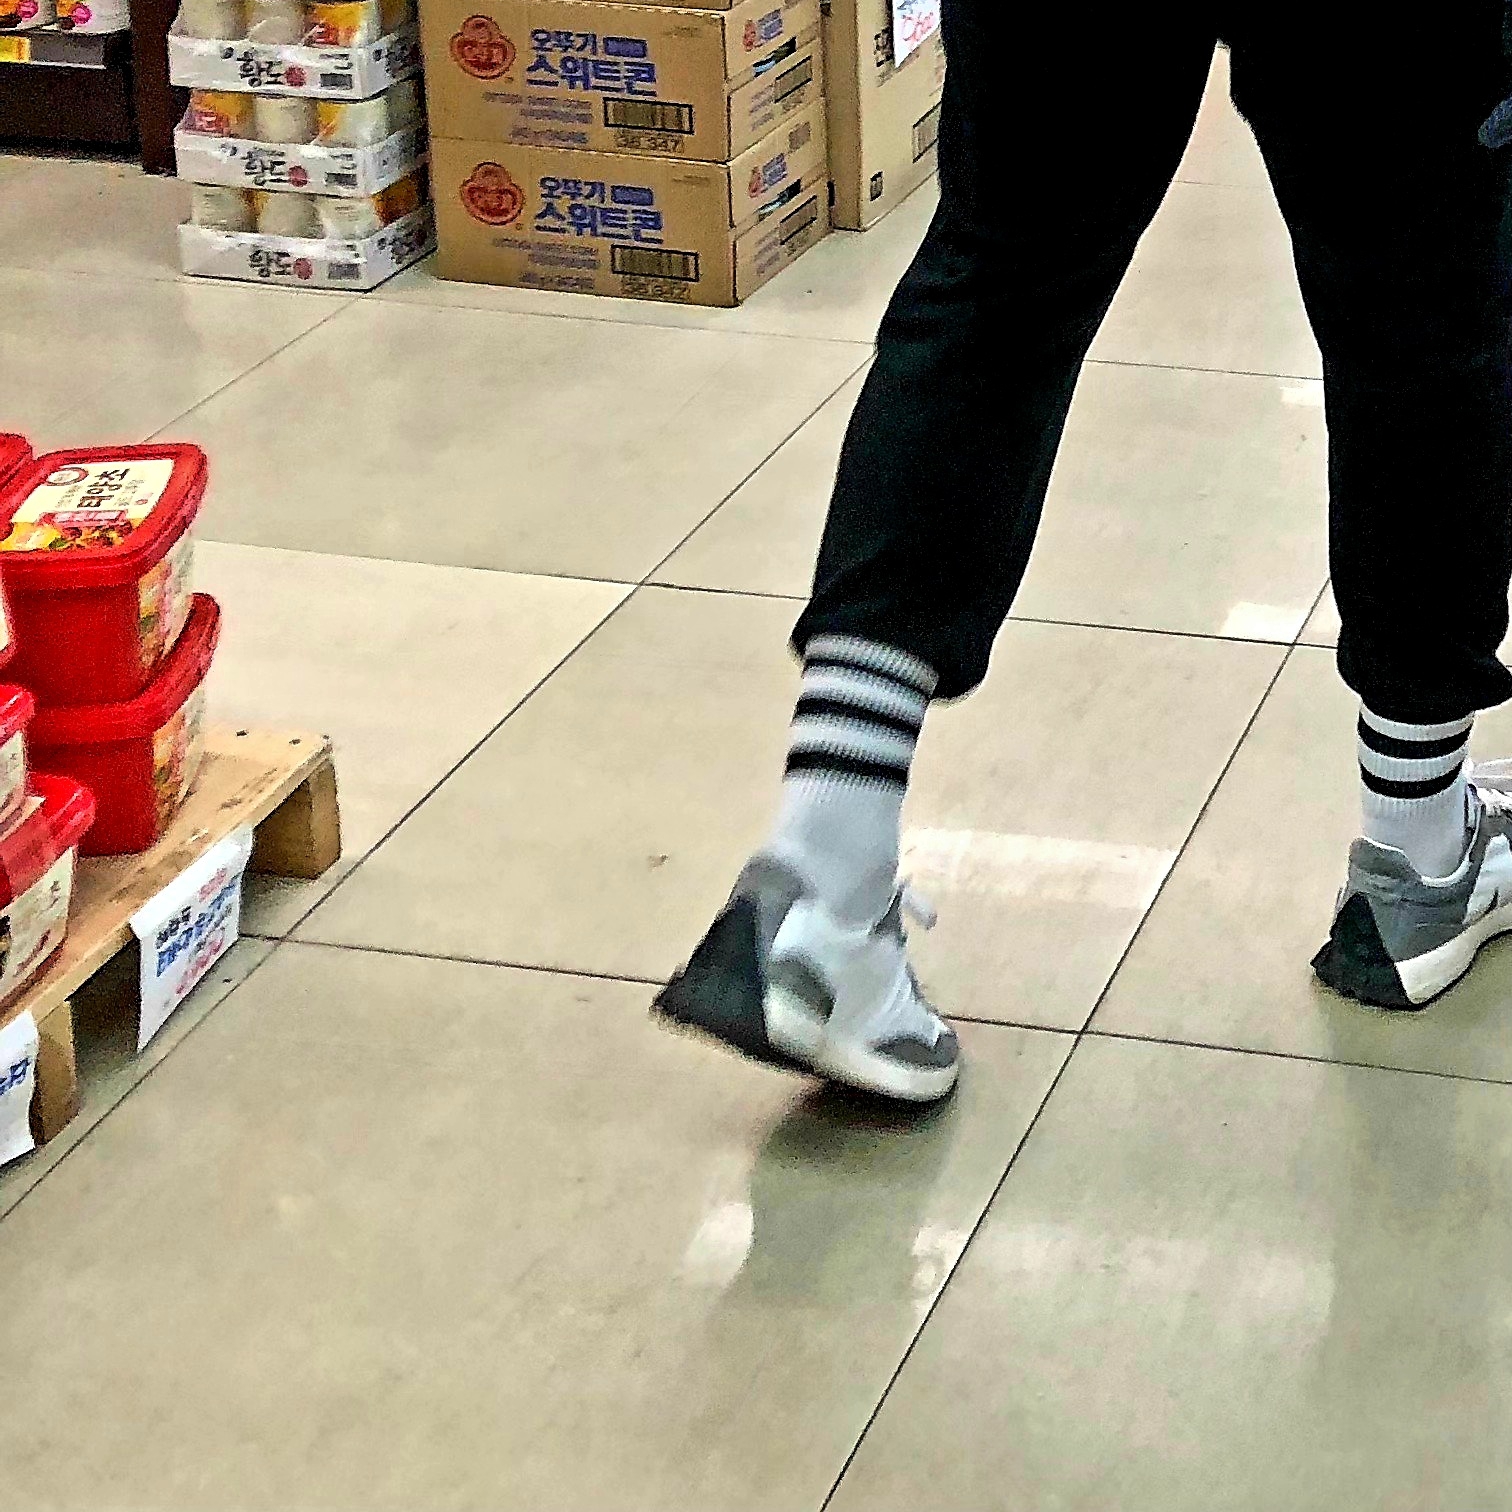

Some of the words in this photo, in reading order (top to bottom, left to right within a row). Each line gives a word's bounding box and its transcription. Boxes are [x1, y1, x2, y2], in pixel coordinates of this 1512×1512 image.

[530, 28, 598, 55] 오뚜기
[526, 54, 658, 97] 스위트콘
[539, 176, 607, 203] 오뚜기
[534, 201, 664, 245] 스위트콘
[77, 467, 130, 508] 태양초
